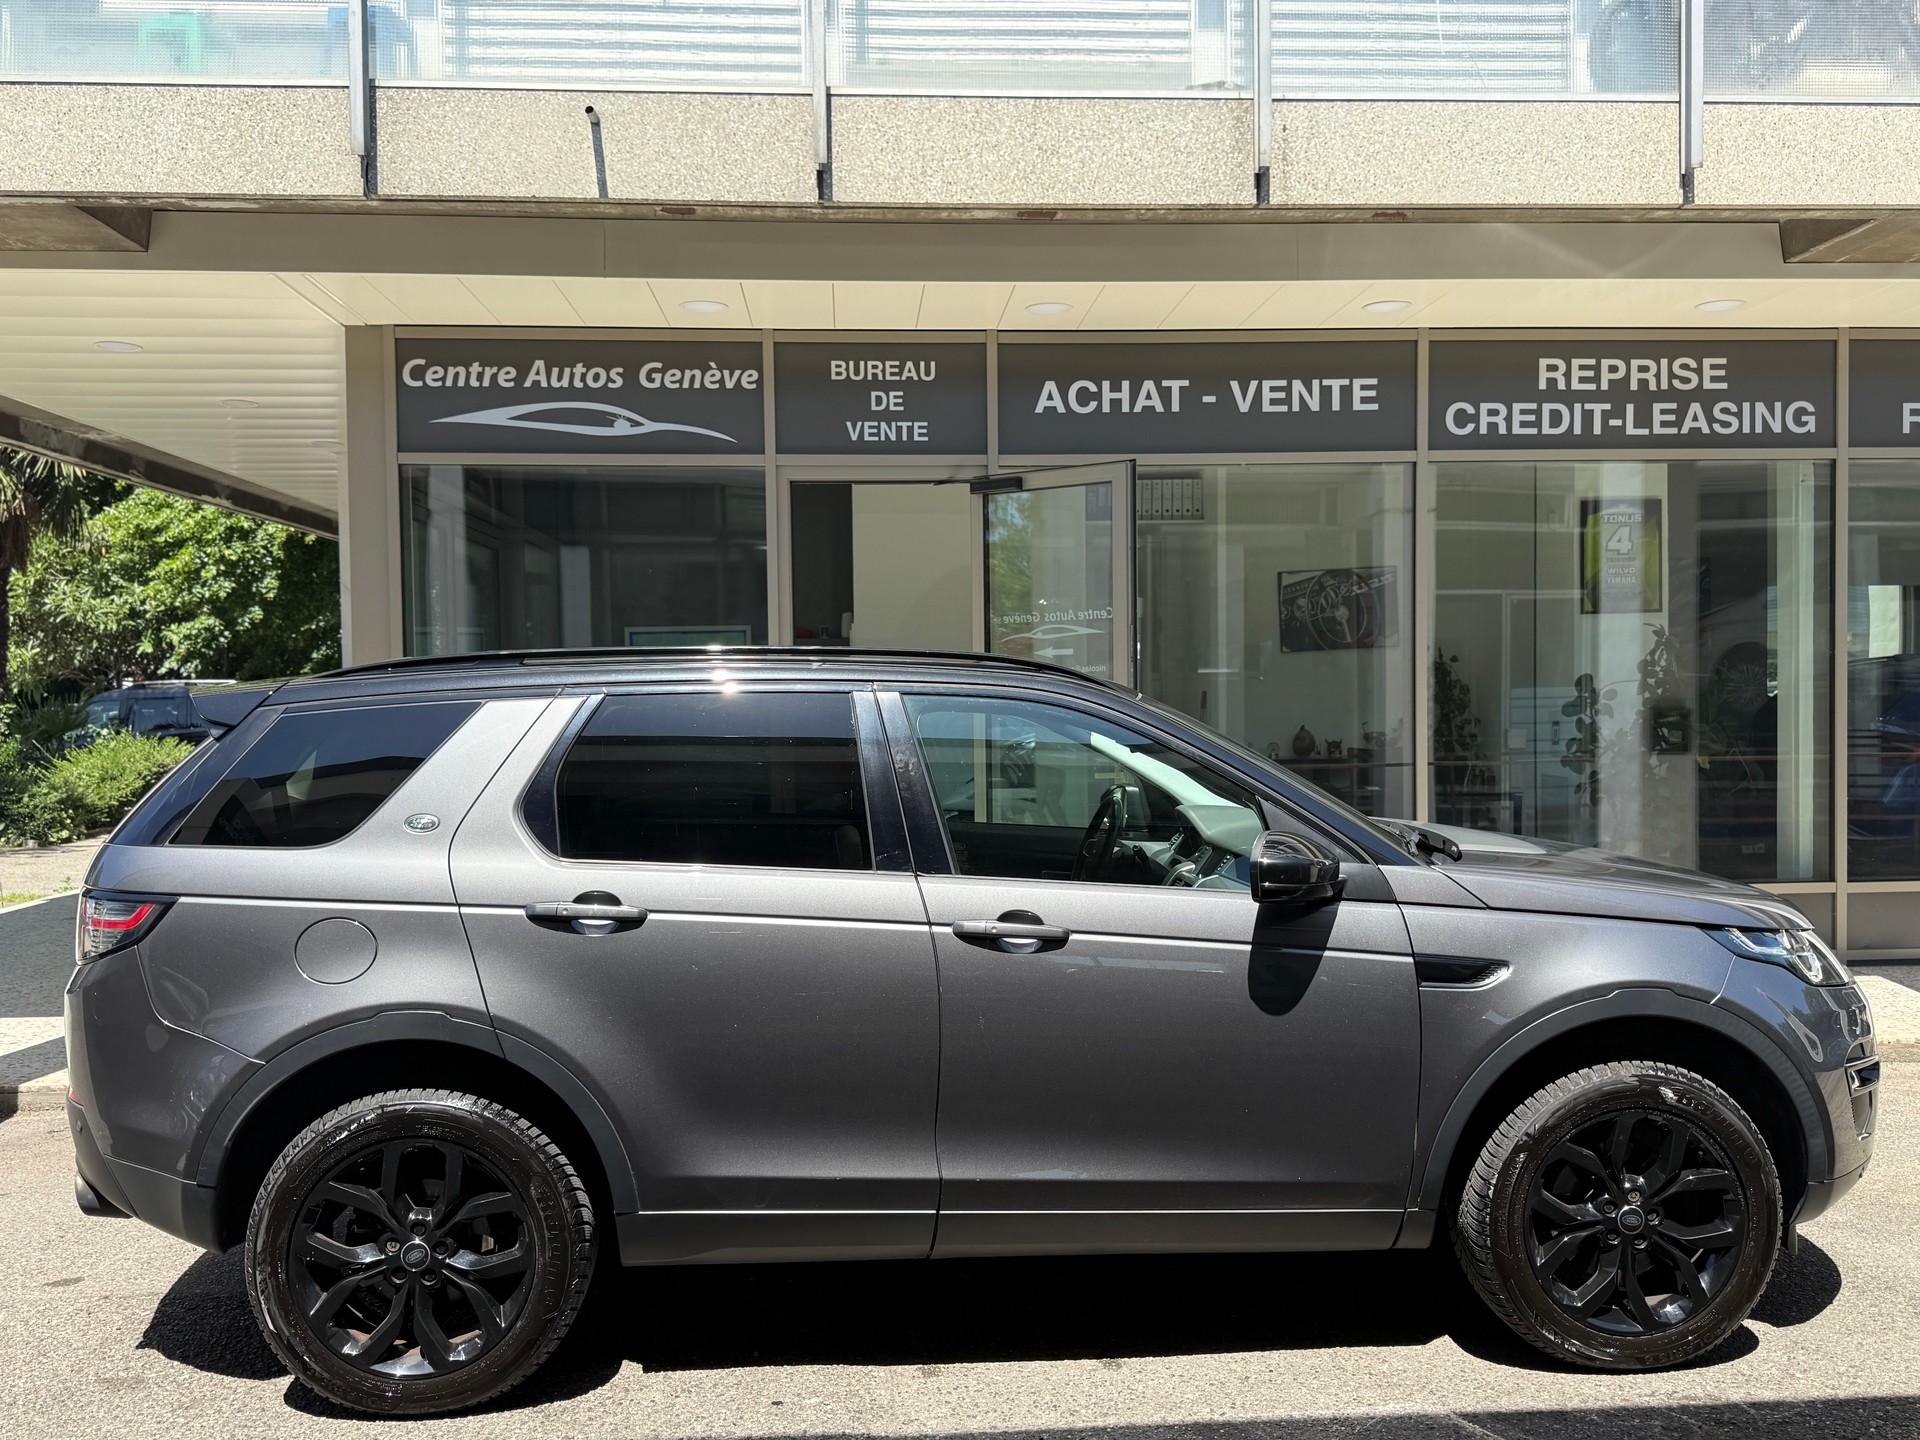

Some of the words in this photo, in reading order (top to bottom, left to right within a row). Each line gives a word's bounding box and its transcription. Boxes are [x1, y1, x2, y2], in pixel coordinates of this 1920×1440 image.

[403, 359, 517, 388] Centre
[524, 360, 624, 389] Autos
[638, 361, 759, 390] Genève
[830, 360, 936, 381] BUREAU
[1538, 356, 1729, 391] REPRISE
[870, 391, 905, 411] DE
[1035, 379, 1190, 414] ACHAT
[1229, 377, 1380, 413] VENTE
[1445, 400, 1816, 436] CREDIT-LEASING
[845, 421, 929, 442] VENTE
[1602, 514, 1643, 523] TONUS
[1606, 526, 1633, 555] 4
[1606, 576, 1636, 584] YAMAHA
